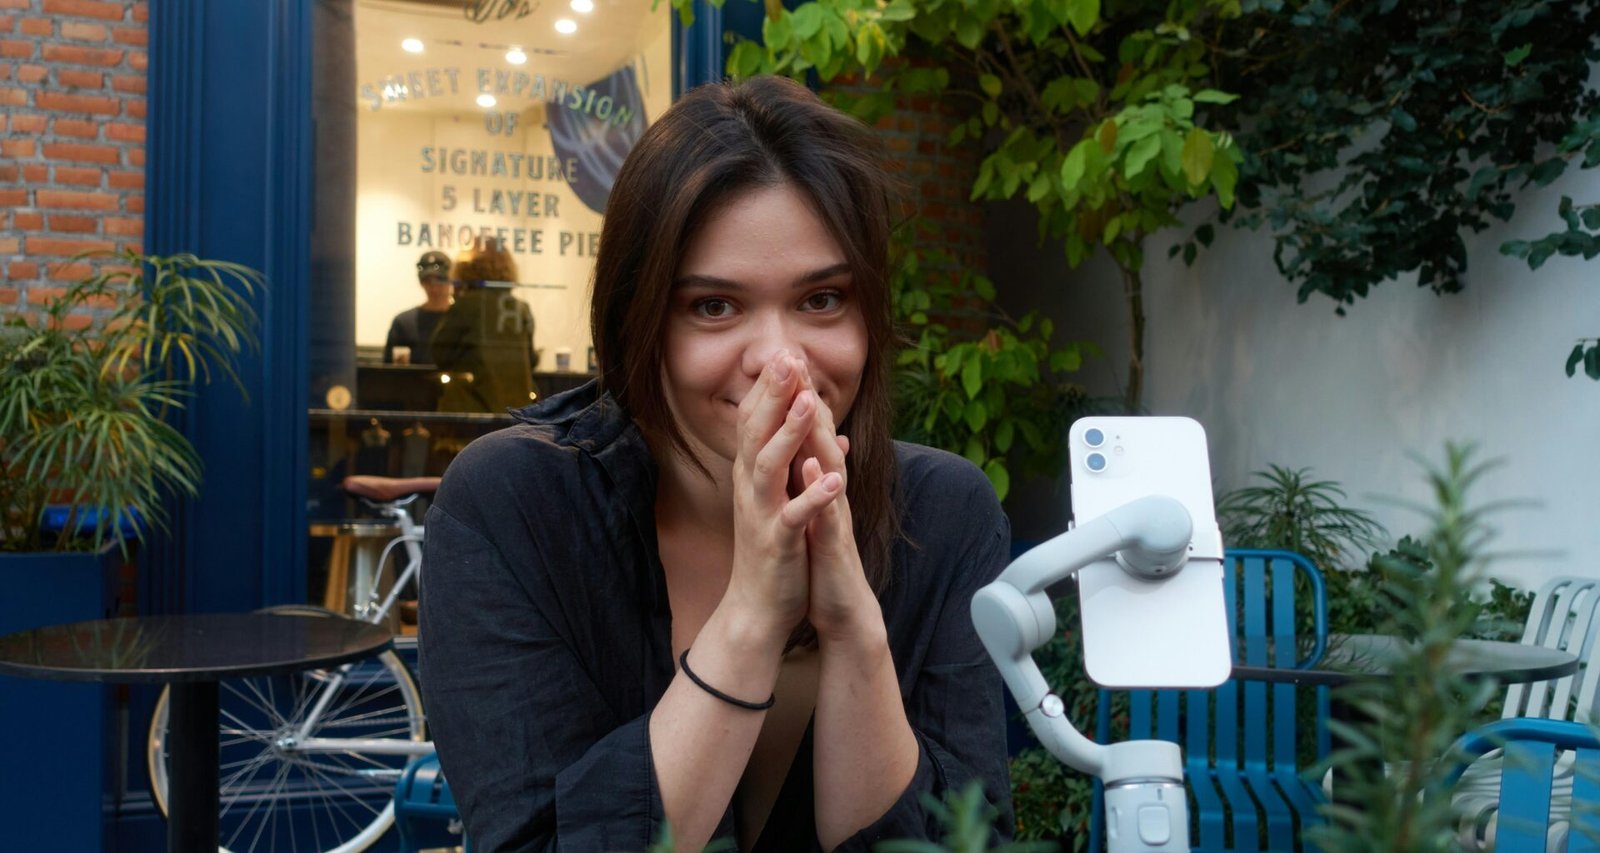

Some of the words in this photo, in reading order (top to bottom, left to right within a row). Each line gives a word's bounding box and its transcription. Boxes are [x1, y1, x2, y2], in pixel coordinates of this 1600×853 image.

[477, 67, 634, 129] EXPANSION
[484, 111, 519, 137] OF
[420, 147, 579, 183] SIGNATURE
[442, 187, 457, 211] 5
[473, 188, 560, 218] LAYER
[397, 222, 544, 254] BANOFFEE
[559, 231, 600, 258] PIE
